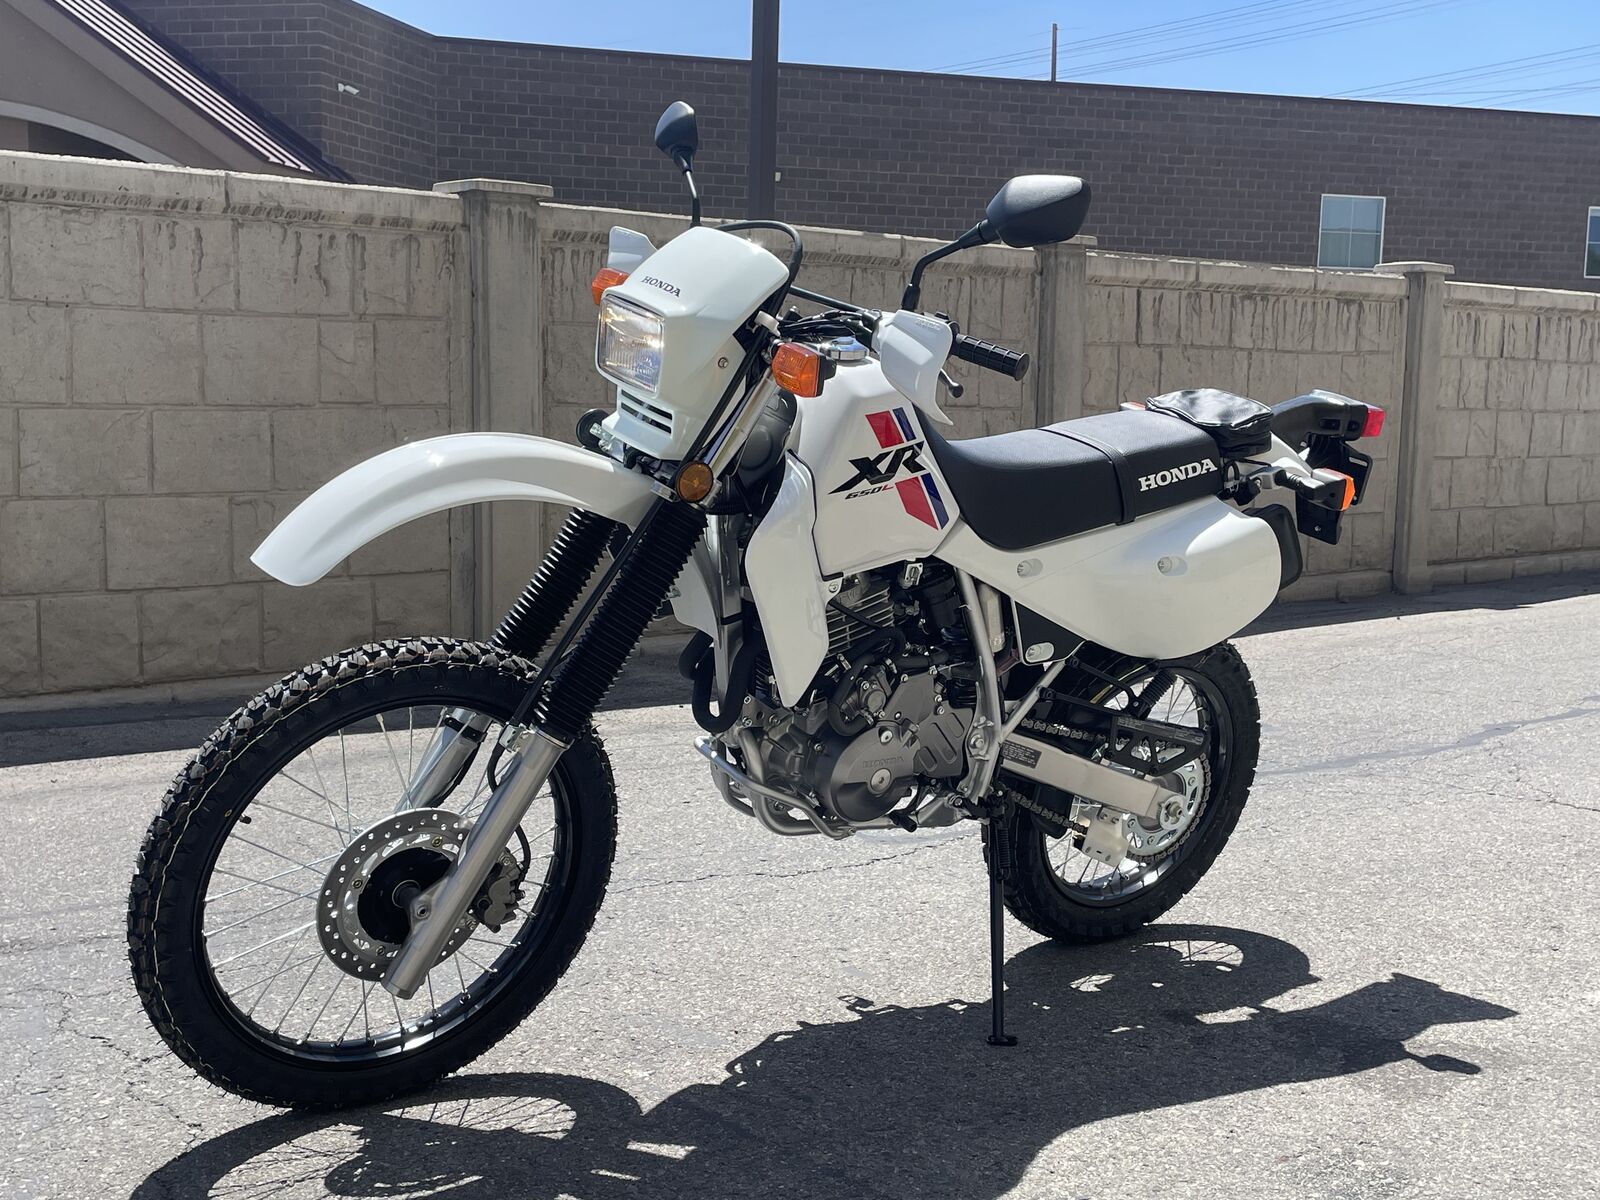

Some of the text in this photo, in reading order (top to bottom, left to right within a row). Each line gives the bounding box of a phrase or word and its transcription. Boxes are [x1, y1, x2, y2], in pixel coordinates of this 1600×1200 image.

[641, 276, 681, 297] HONDA
[828, 440, 926, 495] XR
[1138, 458, 1218, 492] HONDA
[845, 484, 894, 500] 650L
